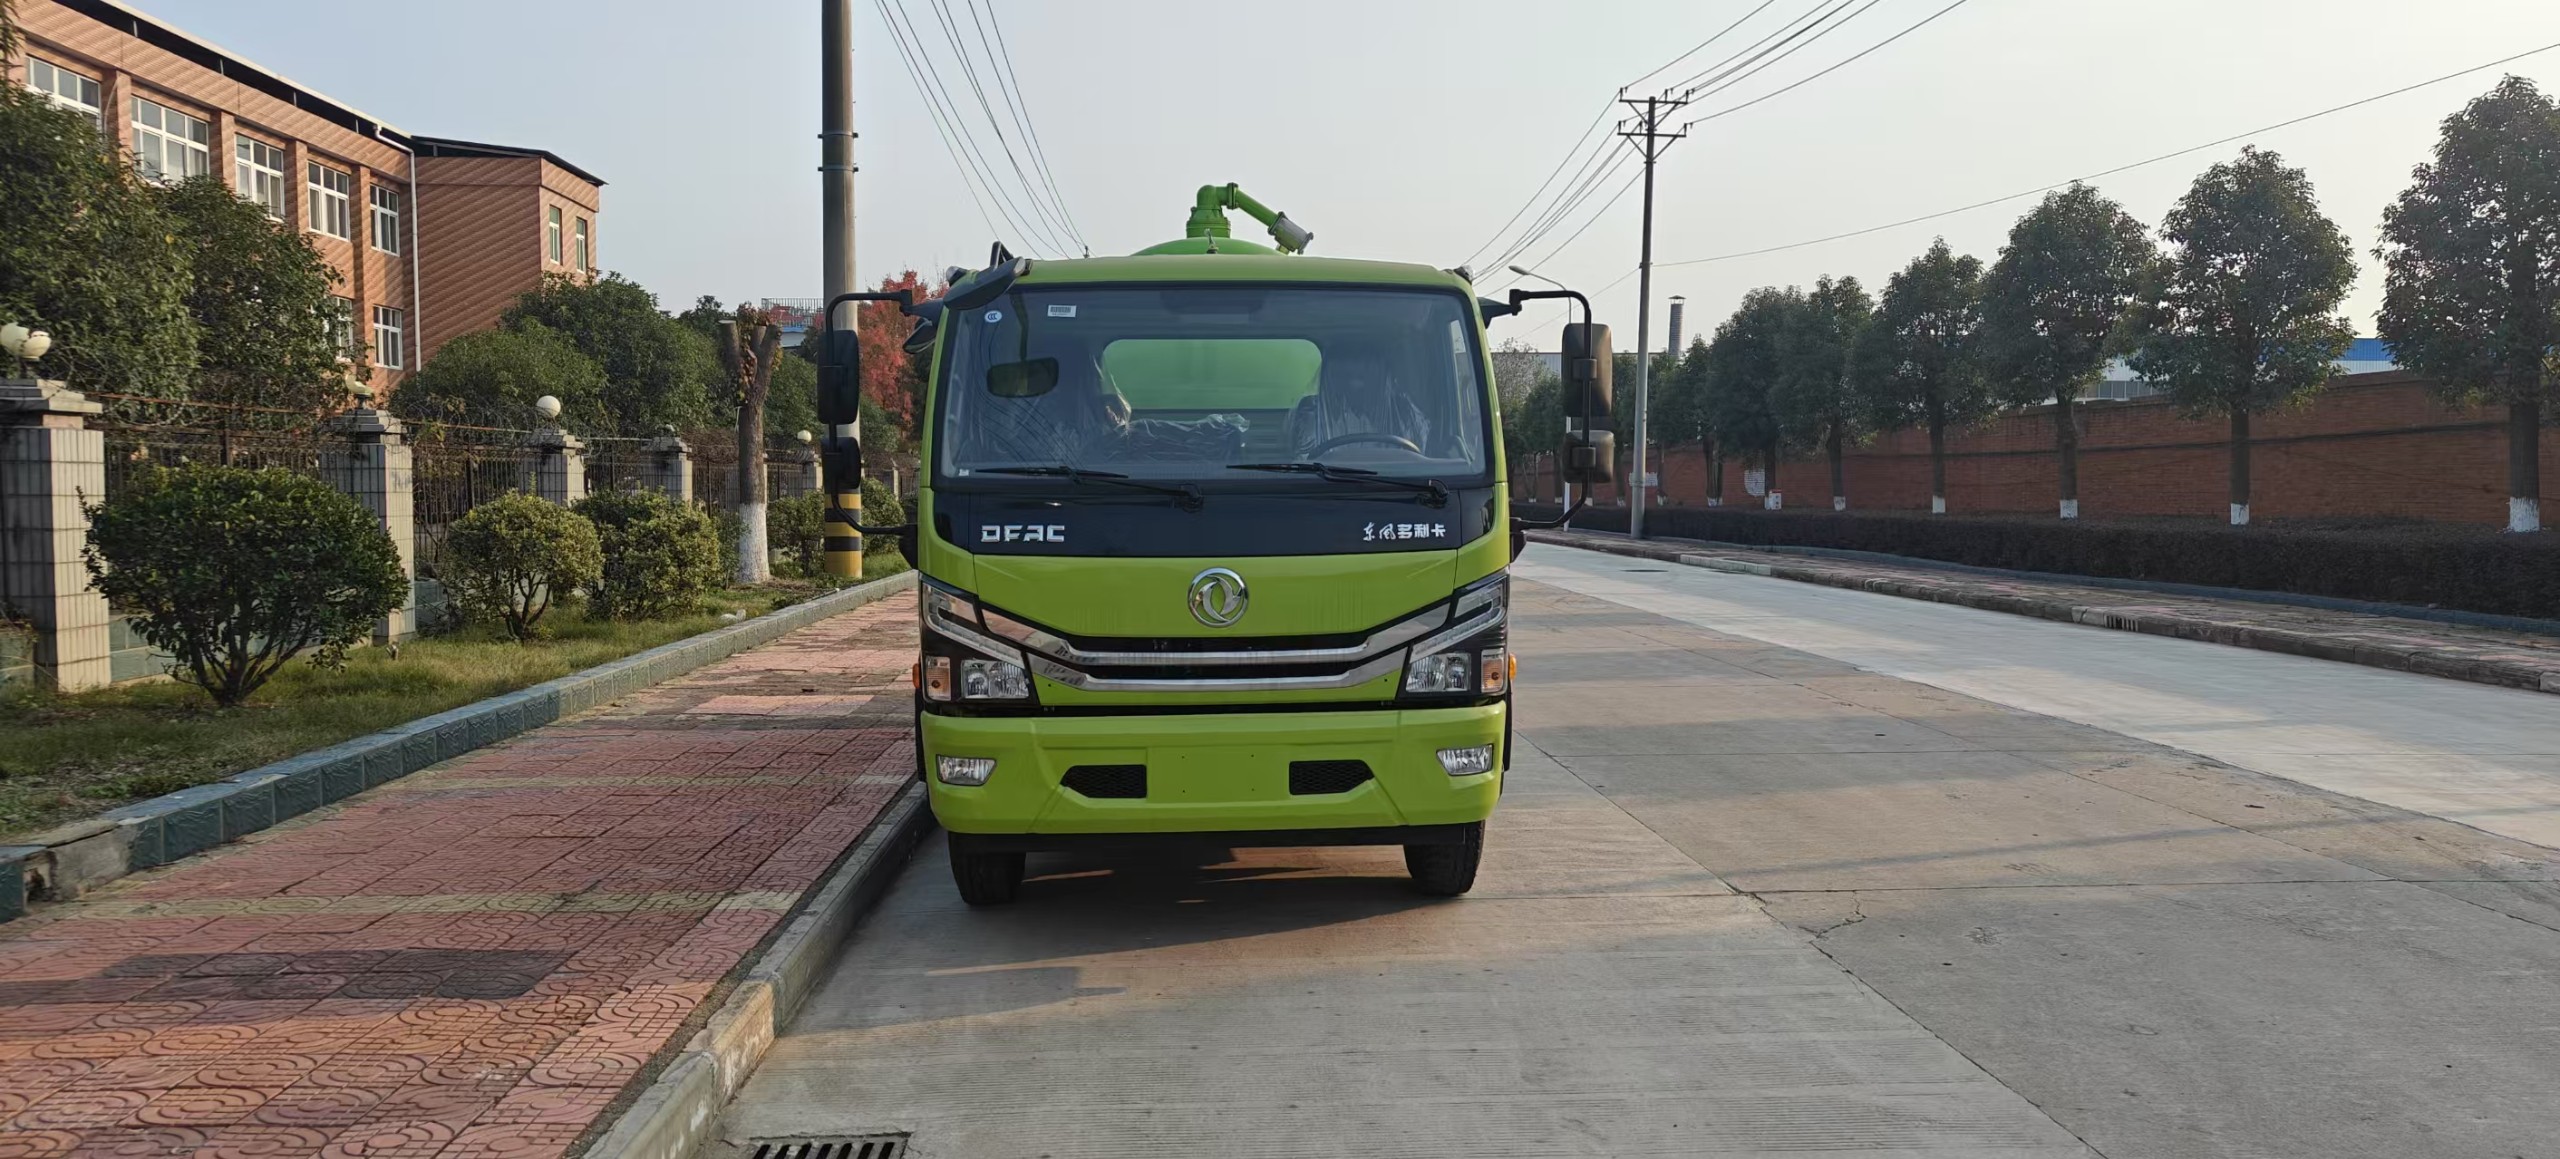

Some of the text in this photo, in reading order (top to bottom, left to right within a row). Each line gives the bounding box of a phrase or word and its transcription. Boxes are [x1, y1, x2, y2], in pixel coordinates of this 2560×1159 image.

[981, 525, 1065, 542] DFAC
[1363, 522, 1446, 541] 东风多利卡
